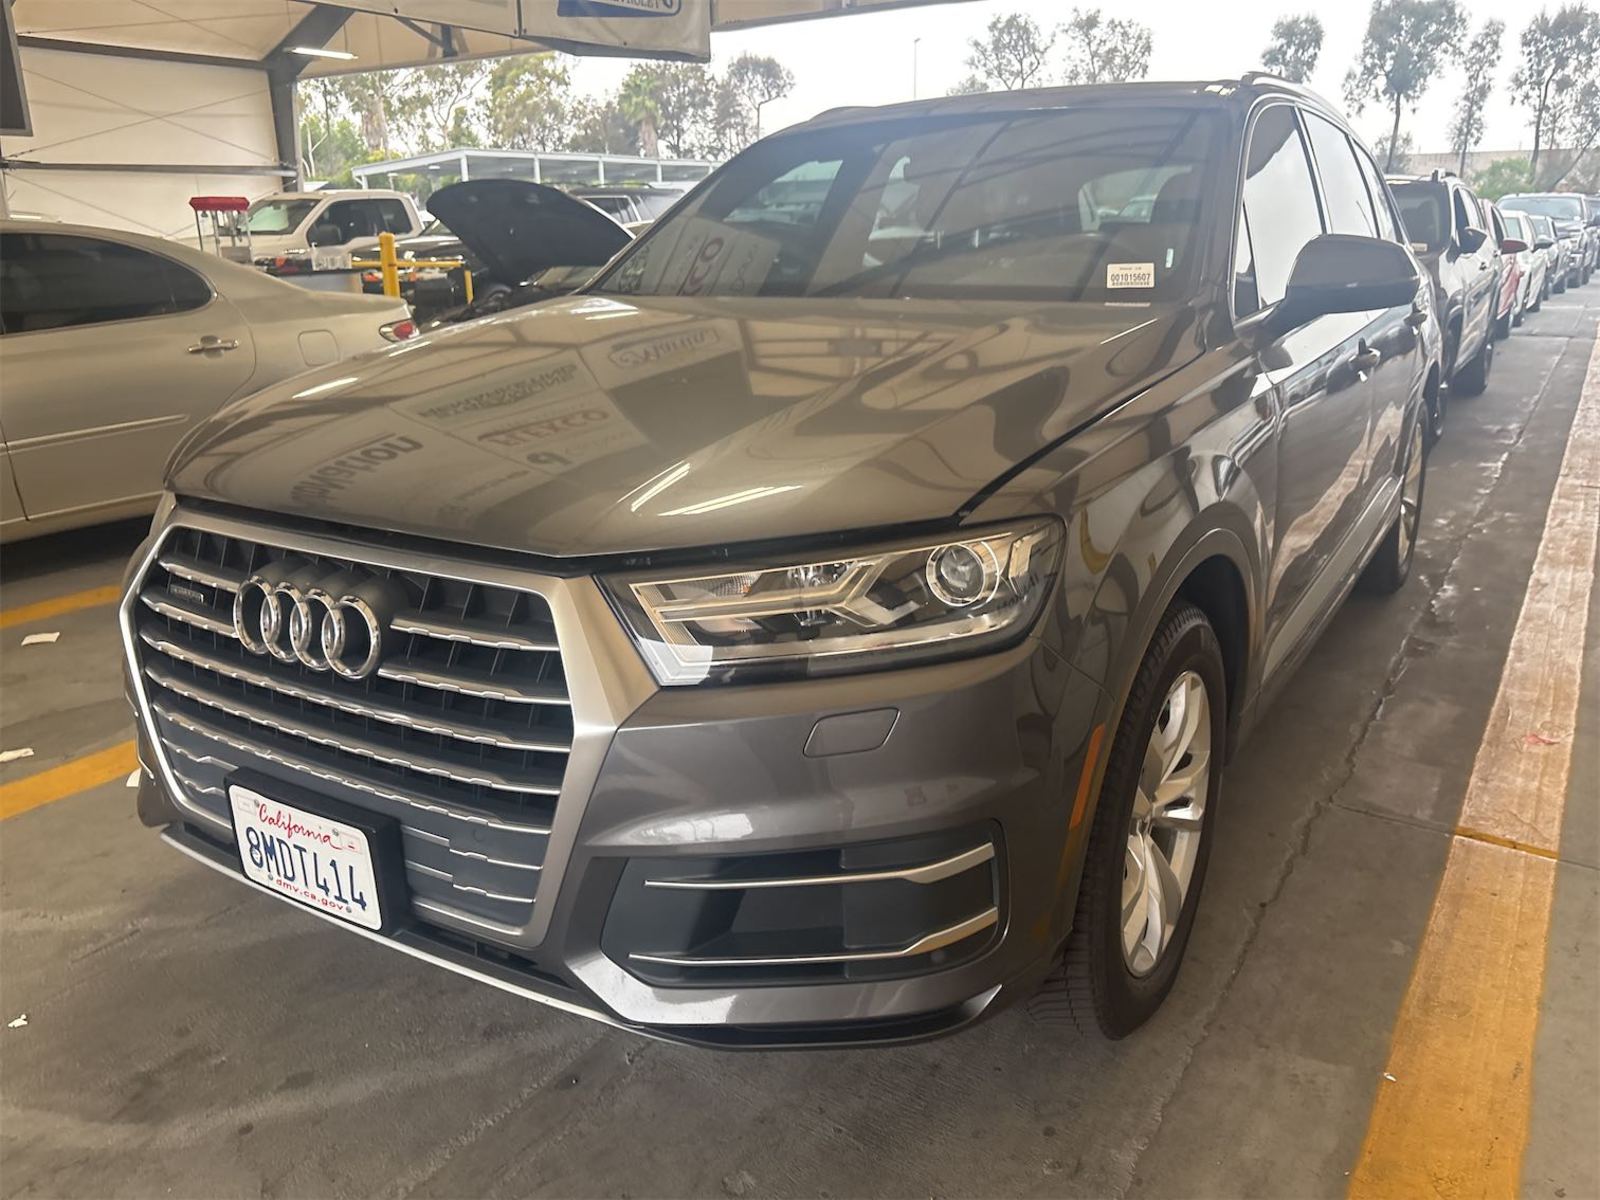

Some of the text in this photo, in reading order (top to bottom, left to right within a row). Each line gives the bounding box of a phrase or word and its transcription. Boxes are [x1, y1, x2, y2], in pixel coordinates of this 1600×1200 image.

[258, 803, 342, 850] California
[246, 826, 367, 911] 8MDT414
[276, 878, 344, 911] dmv.ca.gov
